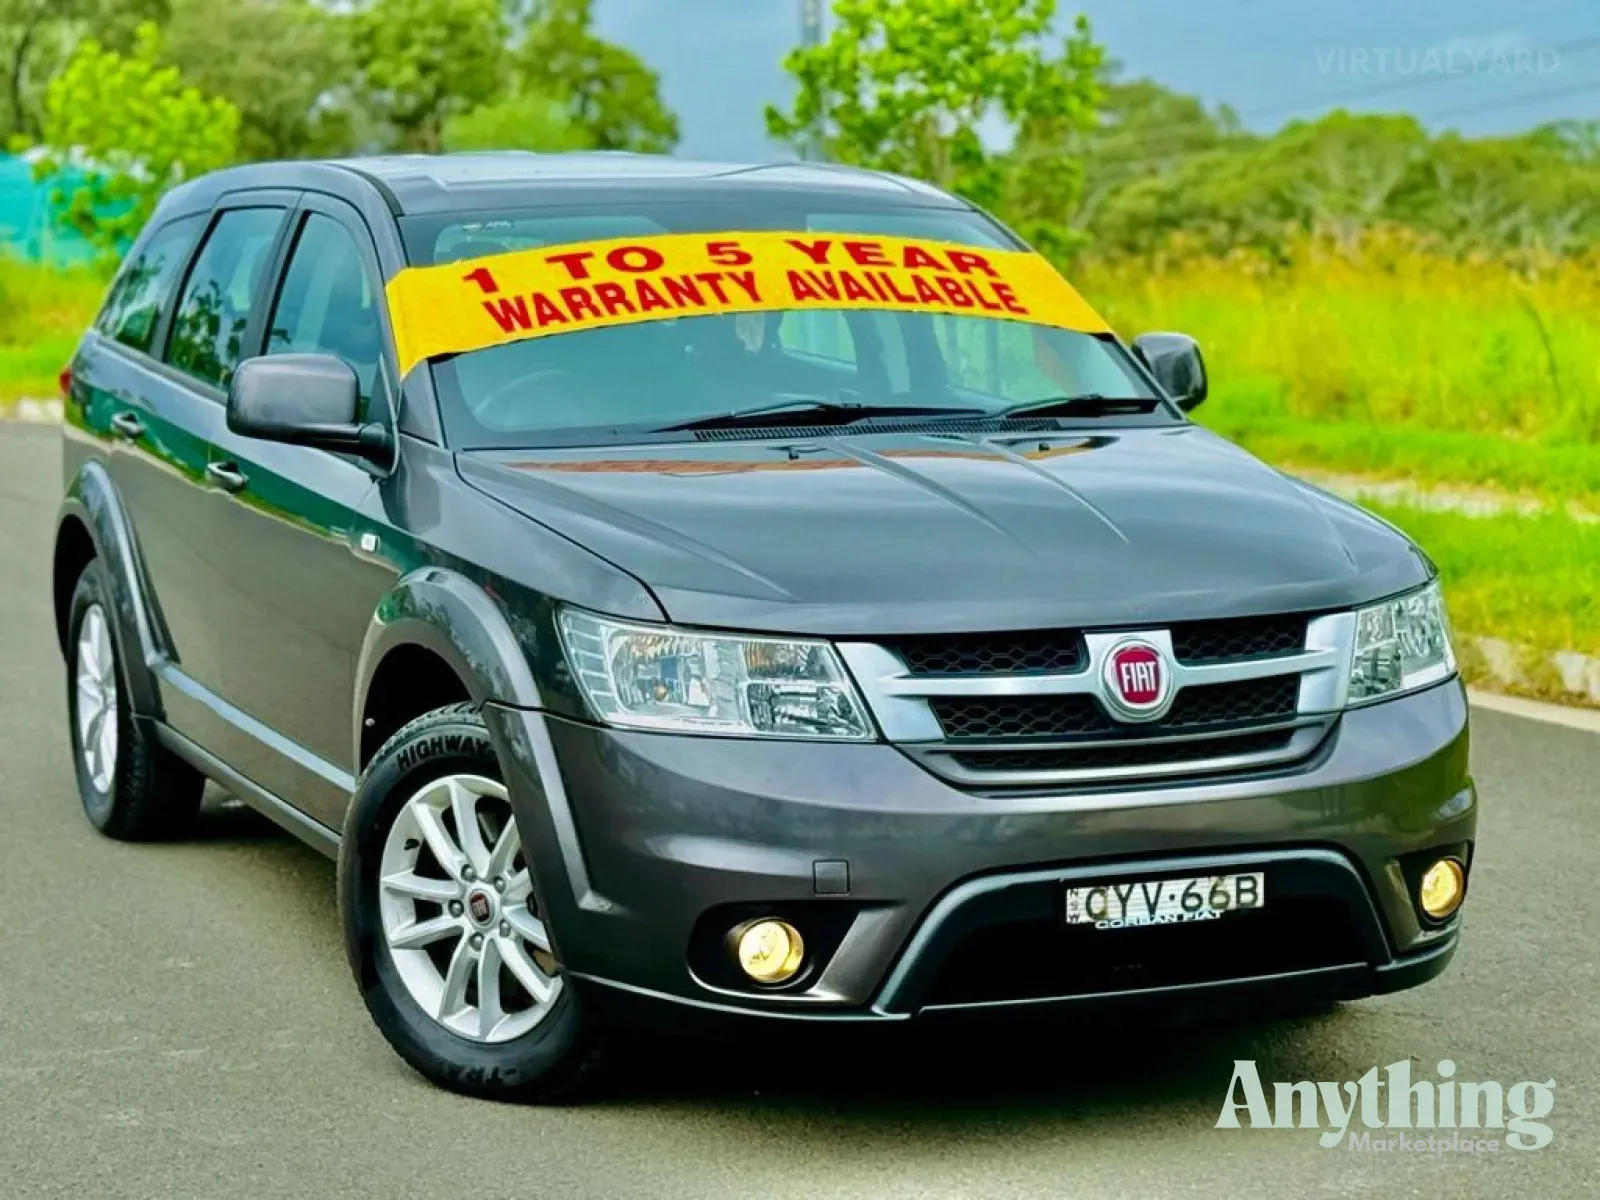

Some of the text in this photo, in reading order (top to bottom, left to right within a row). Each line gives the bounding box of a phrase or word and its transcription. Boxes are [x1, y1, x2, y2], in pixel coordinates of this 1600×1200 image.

[463, 239, 998, 294] 1 TO 5 YEAR
[482, 270, 1028, 333] WARRANTY AVAILABLE
[1120, 661, 1156, 693] FIAT
[396, 735, 491, 770] HIGHWAY
